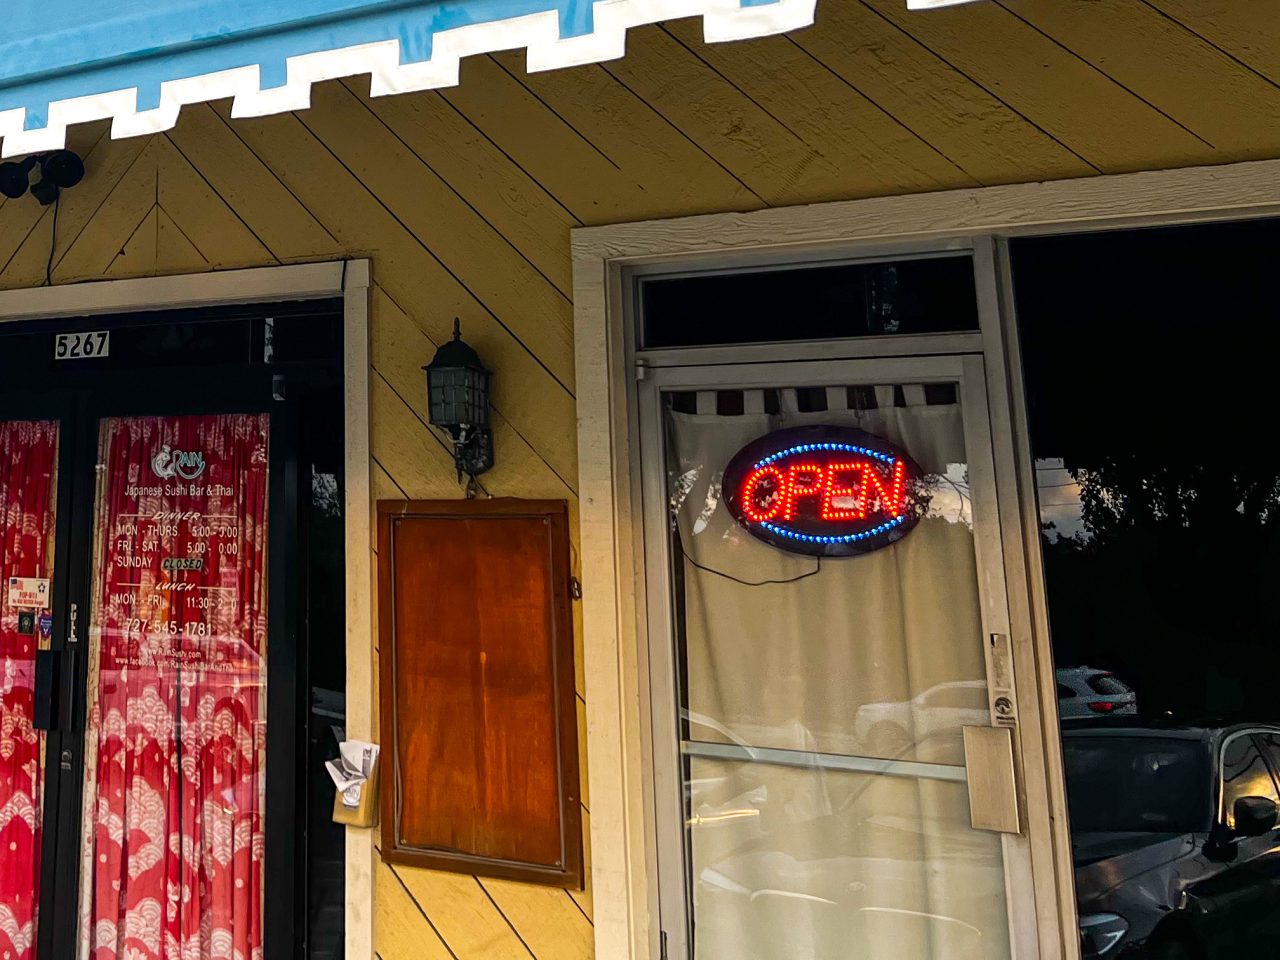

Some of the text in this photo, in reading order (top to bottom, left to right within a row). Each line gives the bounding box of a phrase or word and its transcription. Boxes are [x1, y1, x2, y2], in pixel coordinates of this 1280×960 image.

[57, 333, 108, 357] 5267
[173, 450, 206, 479] RAIN
[125, 484, 234, 498] Japanese Sushi Bar & Thai
[742, 457, 906, 523] OPEN
[152, 511, 201, 521] DINNER
[187, 542, 206, 553] 5:00
[117, 556, 202, 569] SUNDAY CLOSED
[156, 582, 196, 591] LUNCH
[186, 596, 209, 609] 11:30
